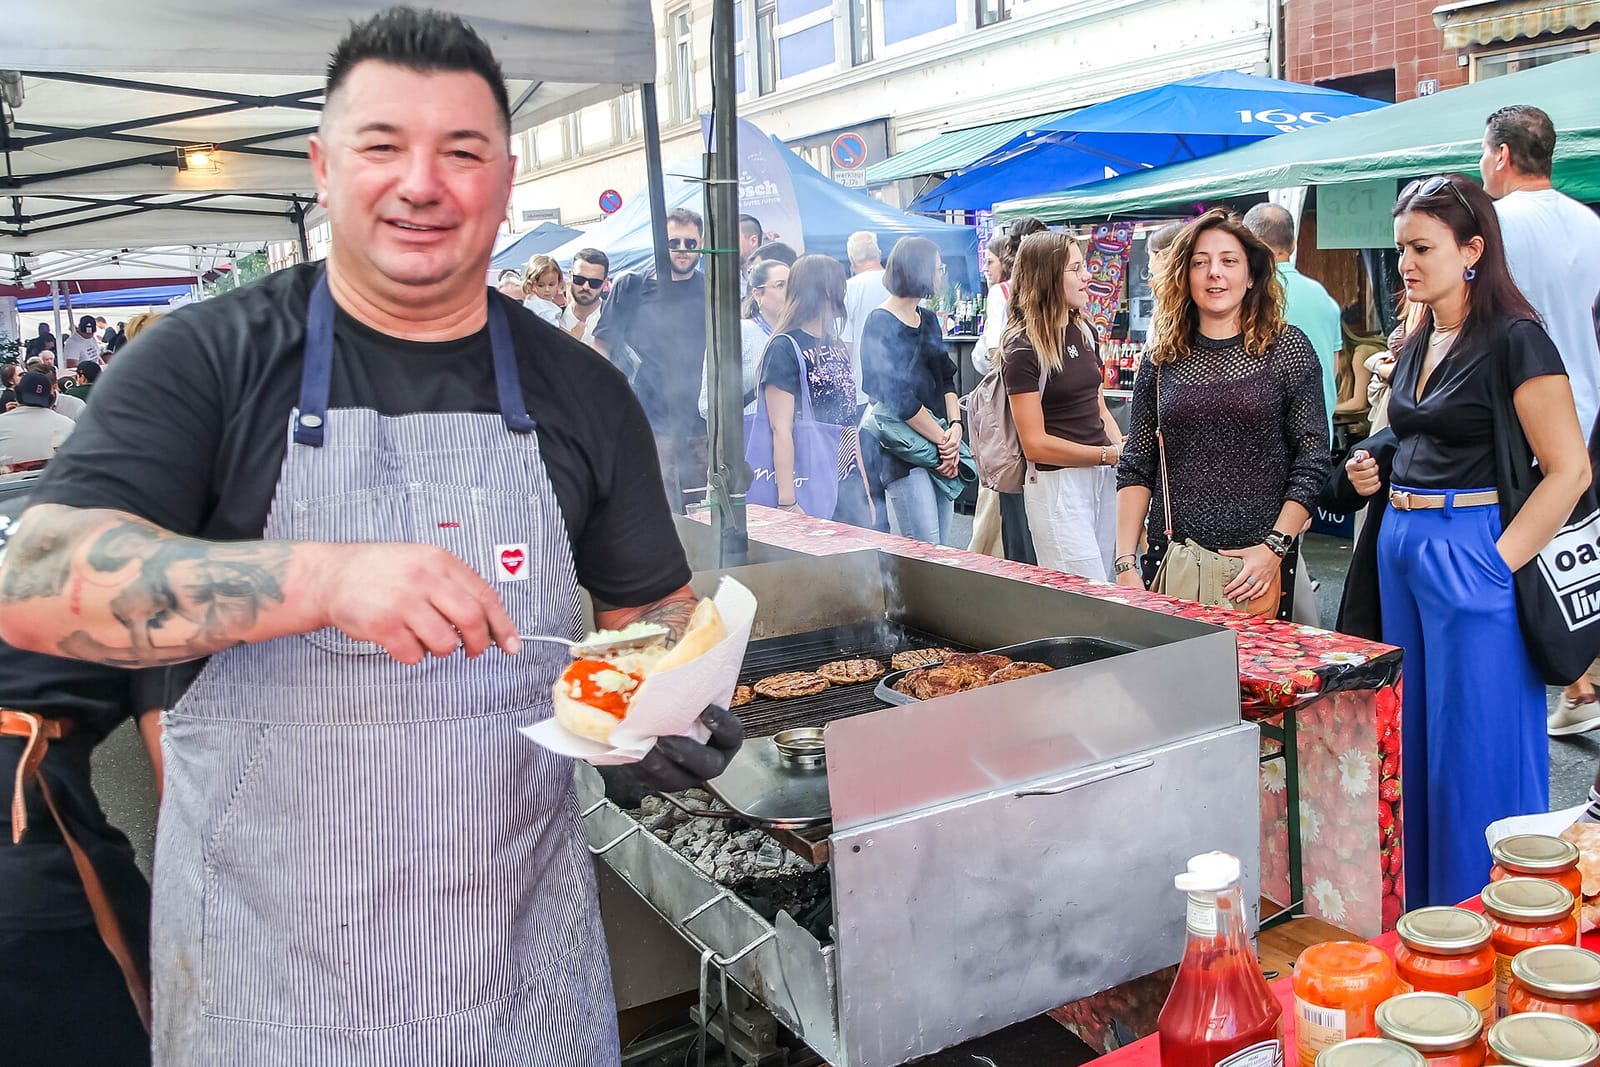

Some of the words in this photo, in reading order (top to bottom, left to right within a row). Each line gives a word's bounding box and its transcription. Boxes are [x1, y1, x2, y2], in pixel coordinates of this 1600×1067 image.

[1420, 82, 1434, 96] 48
[738, 180, 779, 199] osch
[1555, 535, 1600, 573] oa
